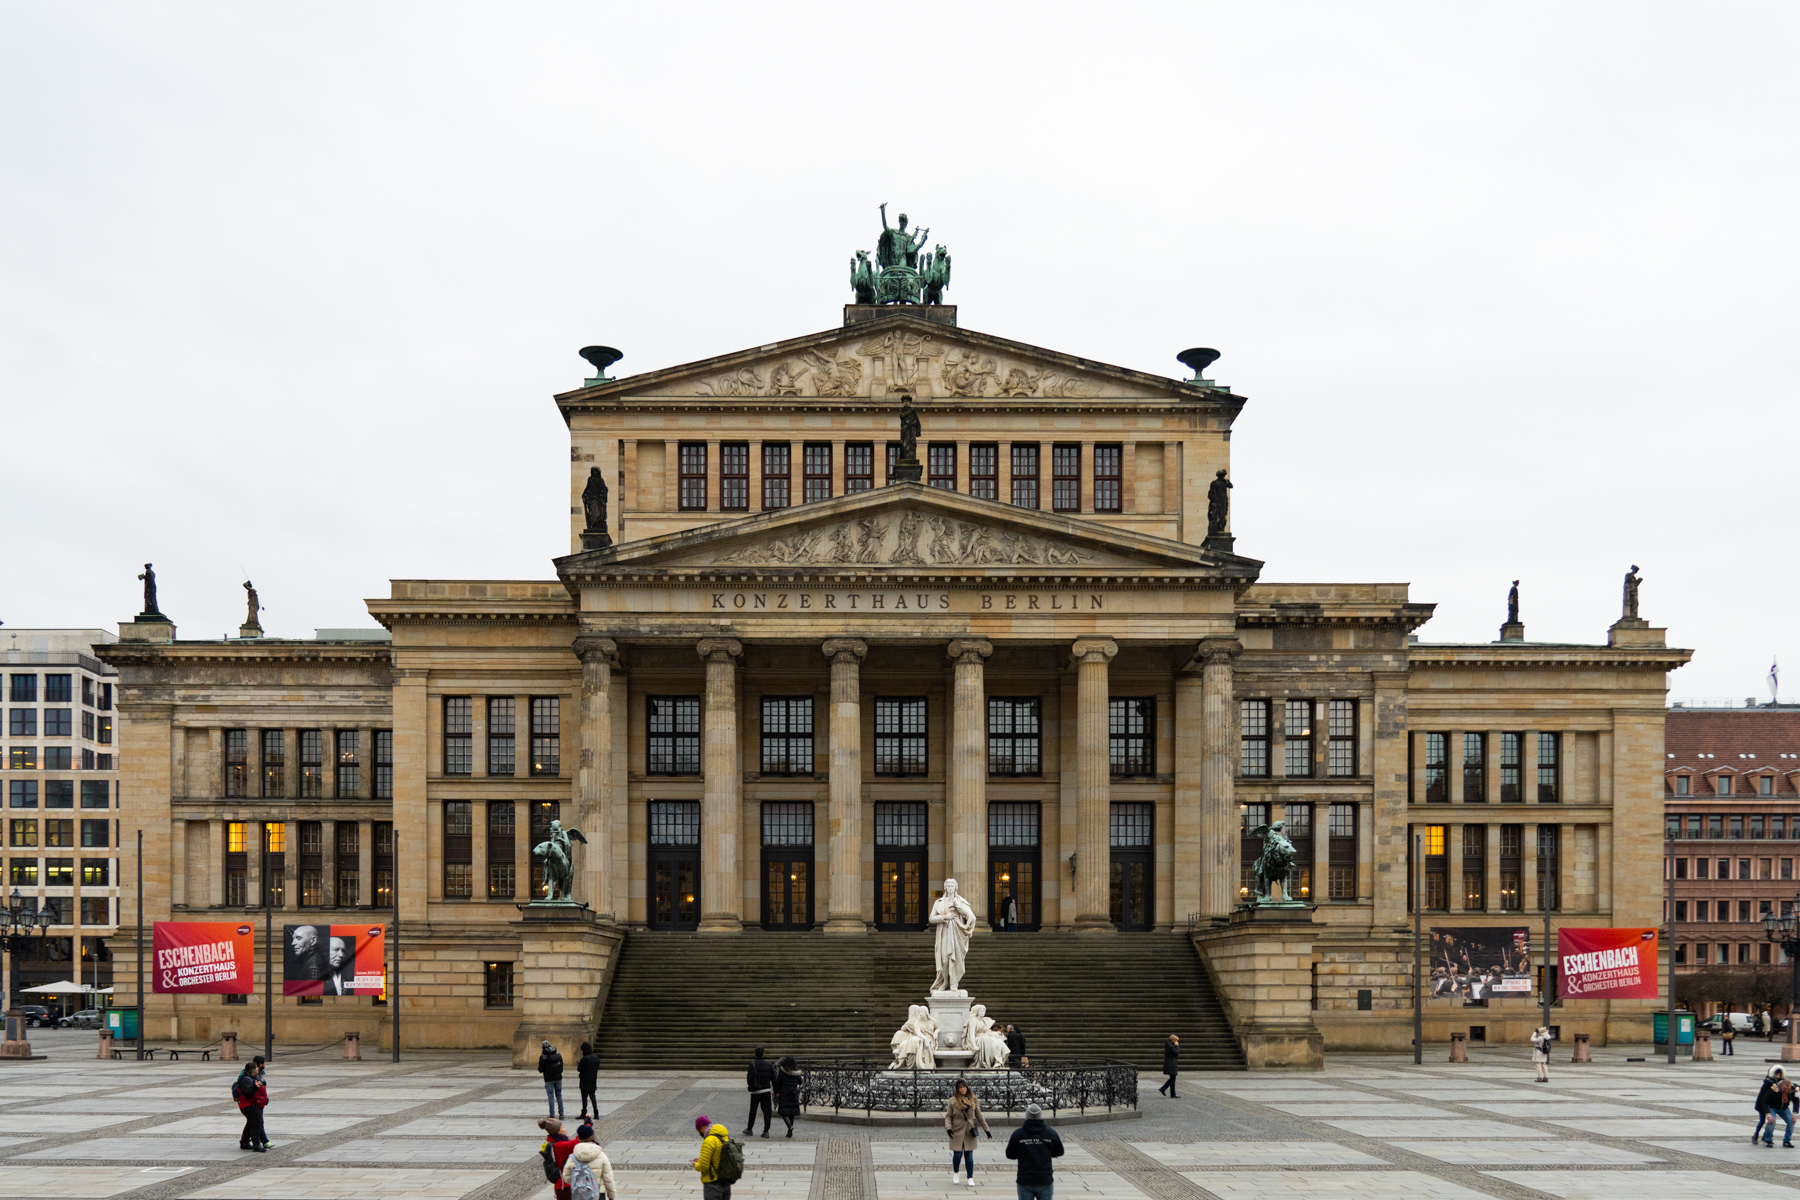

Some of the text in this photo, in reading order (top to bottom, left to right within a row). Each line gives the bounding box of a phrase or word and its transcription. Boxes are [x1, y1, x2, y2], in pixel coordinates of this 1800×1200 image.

[712, 594, 1104, 609] KONZERTHAUS BERLIN
[158, 940, 234, 970] ESCHENBACH
[1563, 946, 1638, 975] ESCHENBACH
[162, 961, 236, 988] & KONZERTHAUS
[178, 971, 237, 987] ORCHESTER BERLIN
[1568, 966, 1639, 994] & KONZERTHAUS
[1583, 976, 1641, 992] ORCHESTER BERLIN
